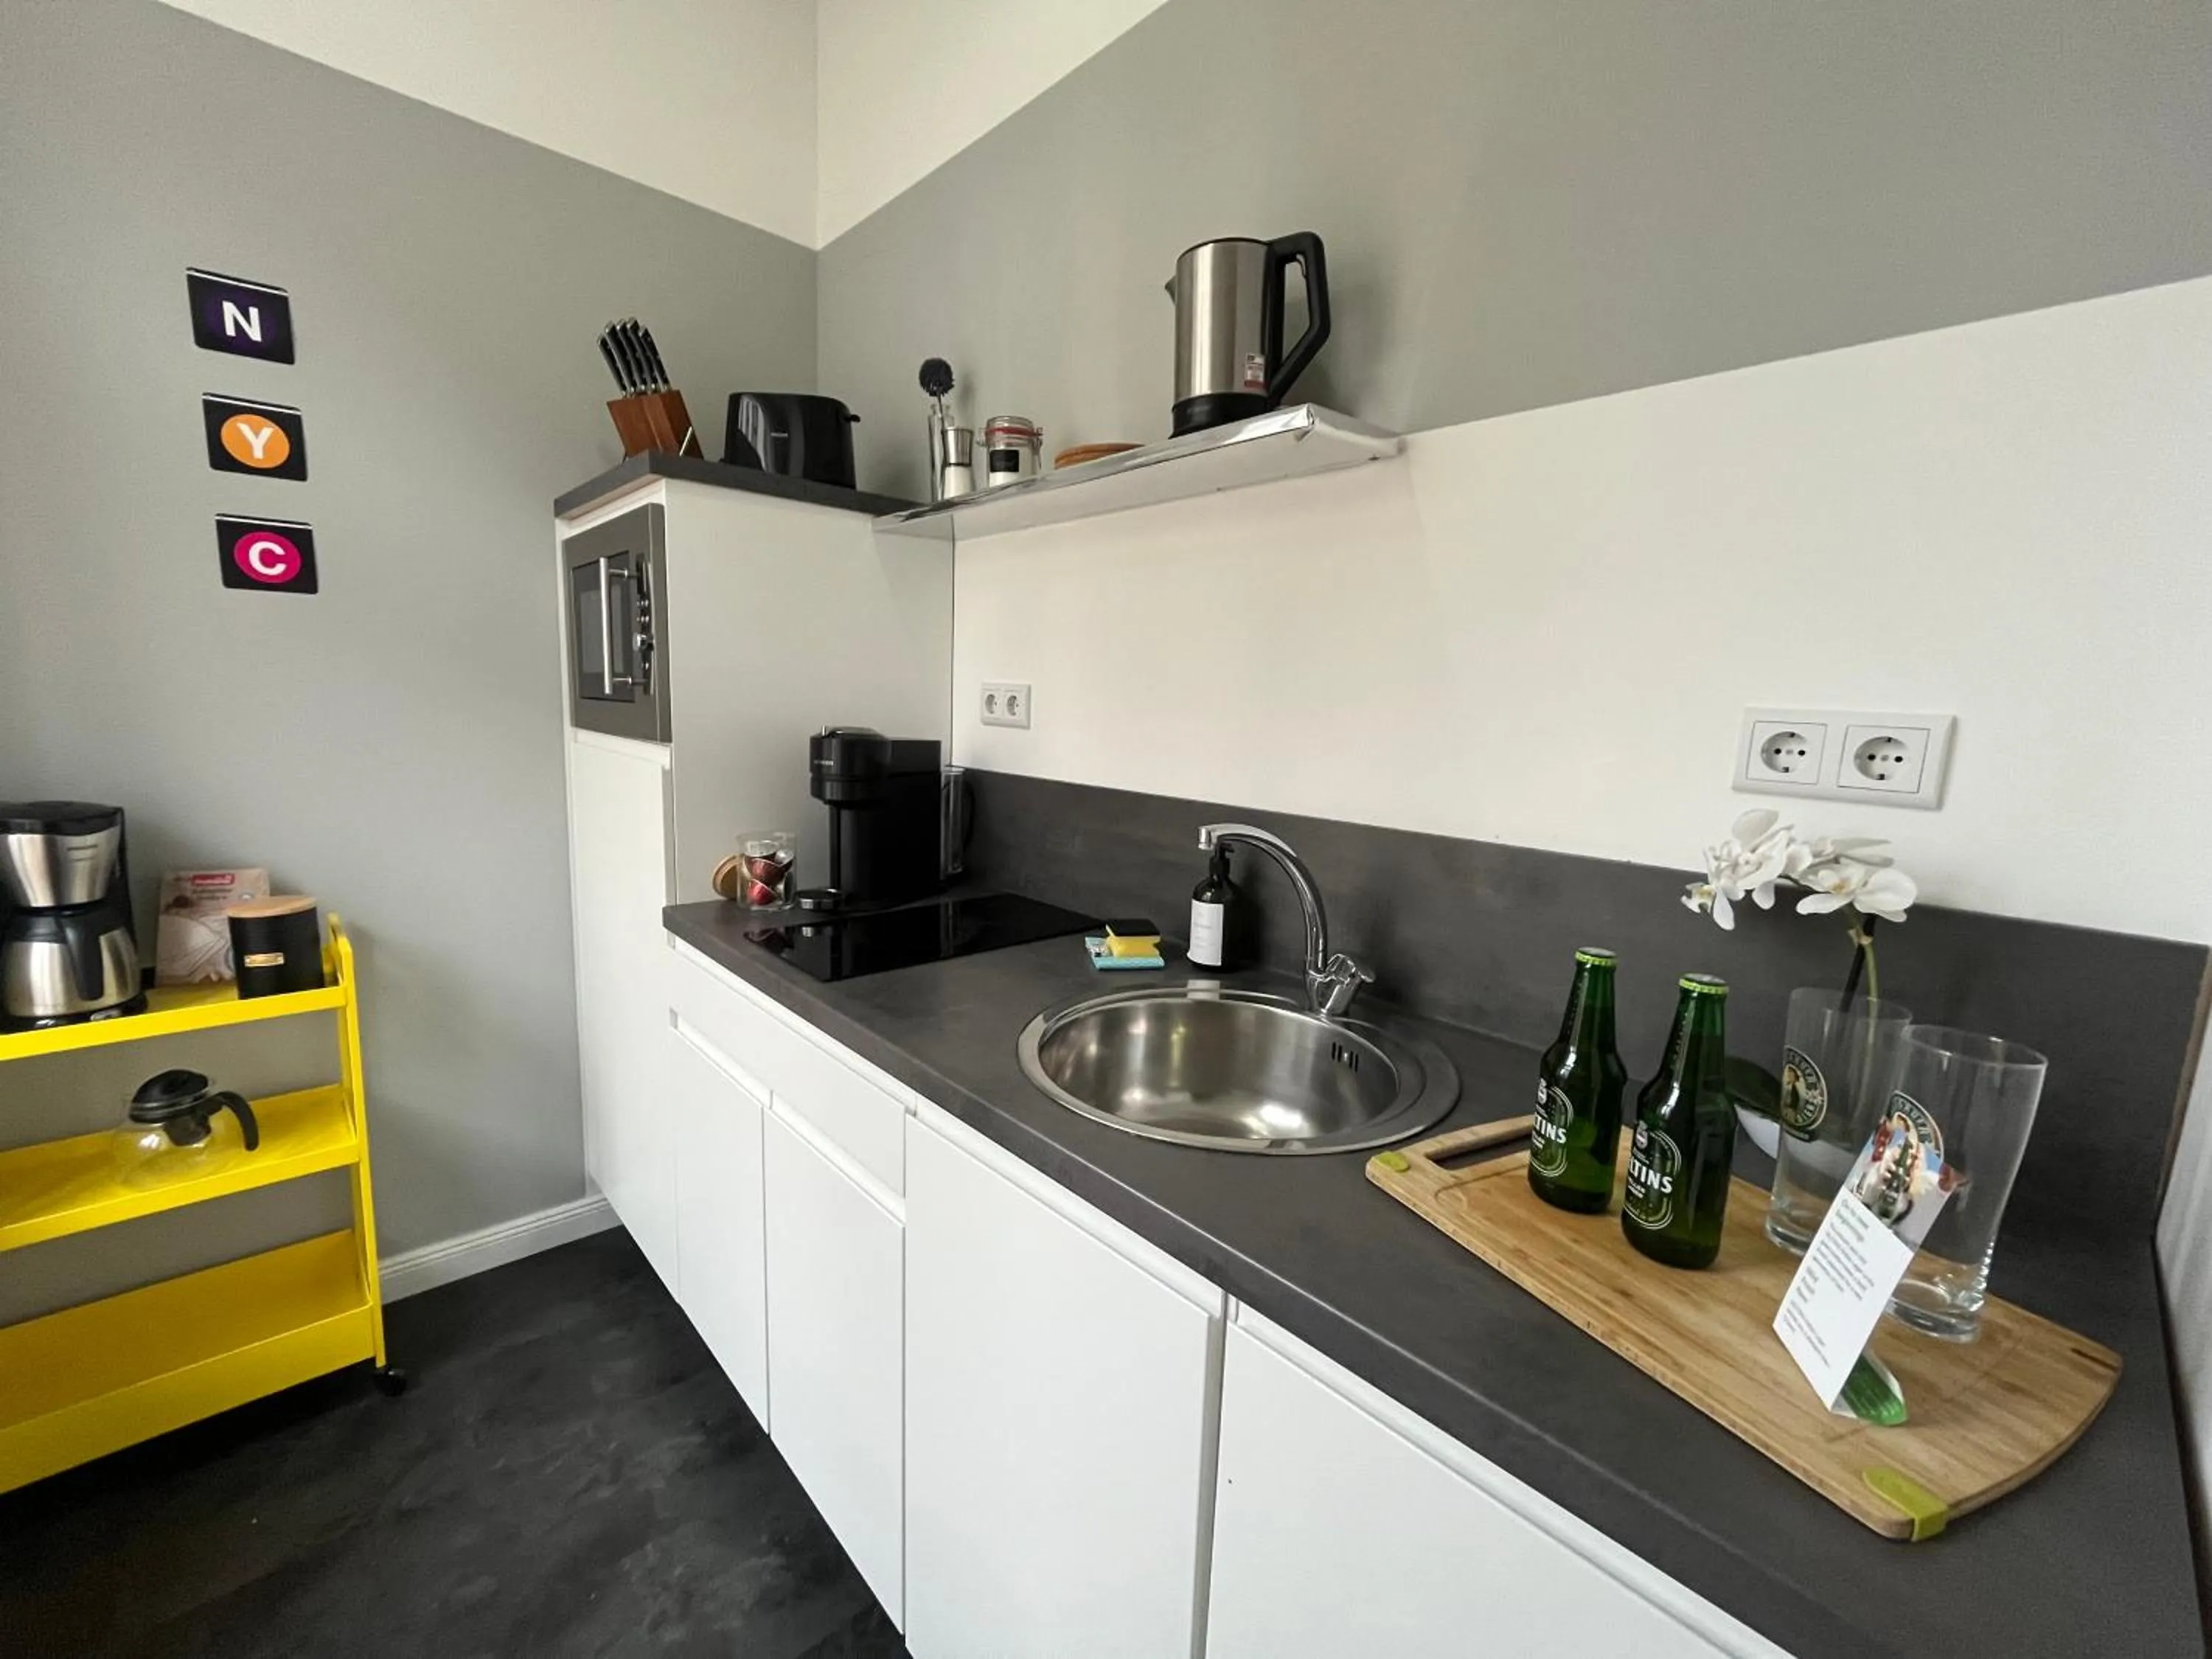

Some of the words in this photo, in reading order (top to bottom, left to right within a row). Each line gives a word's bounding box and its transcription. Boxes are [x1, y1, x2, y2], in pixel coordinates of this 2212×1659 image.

[222, 300, 262, 343] N
[236, 422, 274, 459] Y
[248, 540, 287, 576] C
